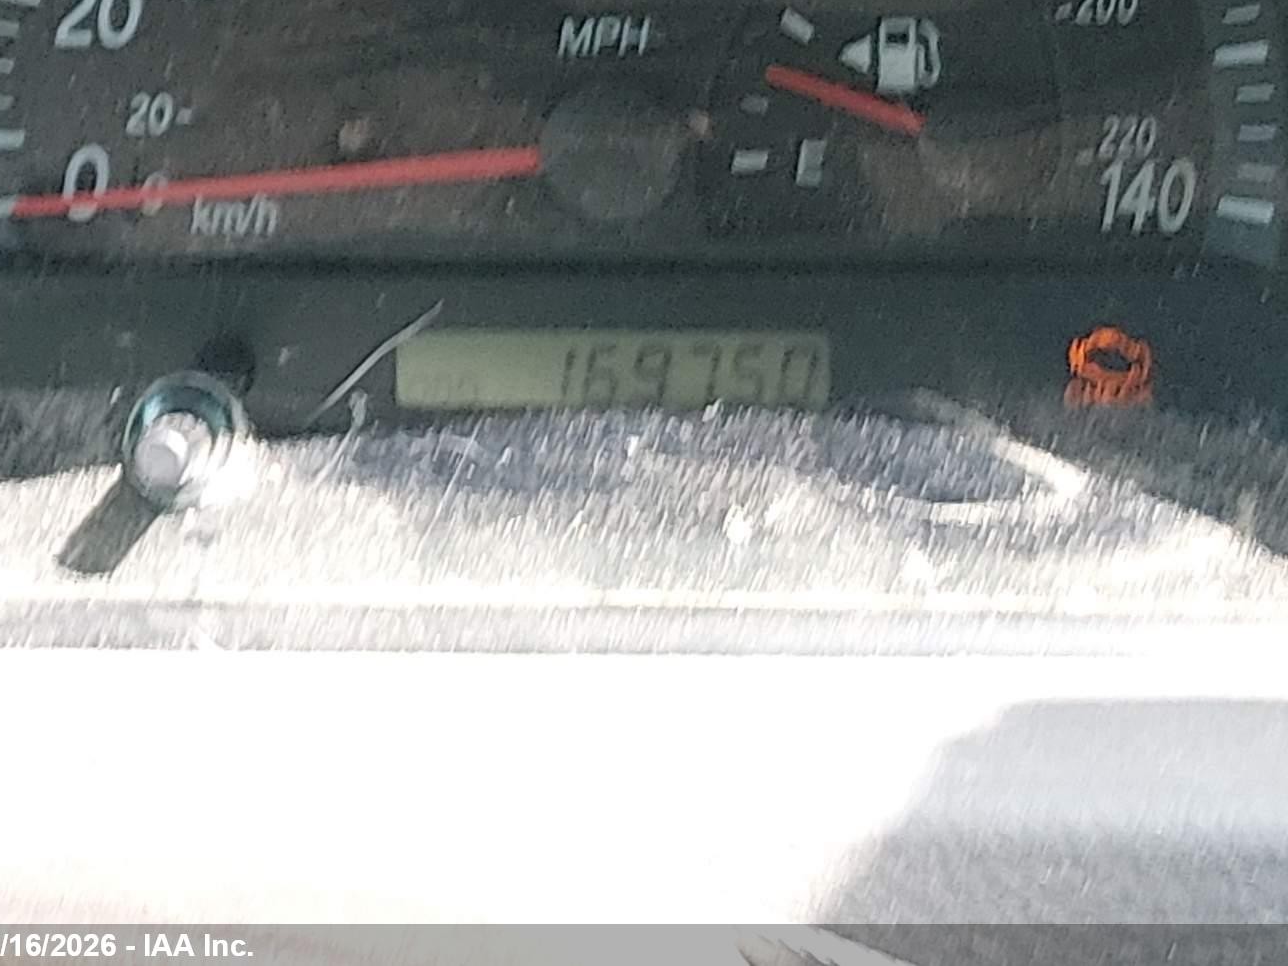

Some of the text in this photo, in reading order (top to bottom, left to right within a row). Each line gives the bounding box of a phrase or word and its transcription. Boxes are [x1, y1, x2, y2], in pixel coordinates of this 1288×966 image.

[558, 16, 652, 58] MPH
[126, 92, 175, 136] 20
[1101, 115, 1158, 162] 220
[61, 144, 111, 223] 0
[1101, 157, 1196, 235] 140
[191, 193, 279, 236] km/h
[561, 342, 818, 405] 169750
